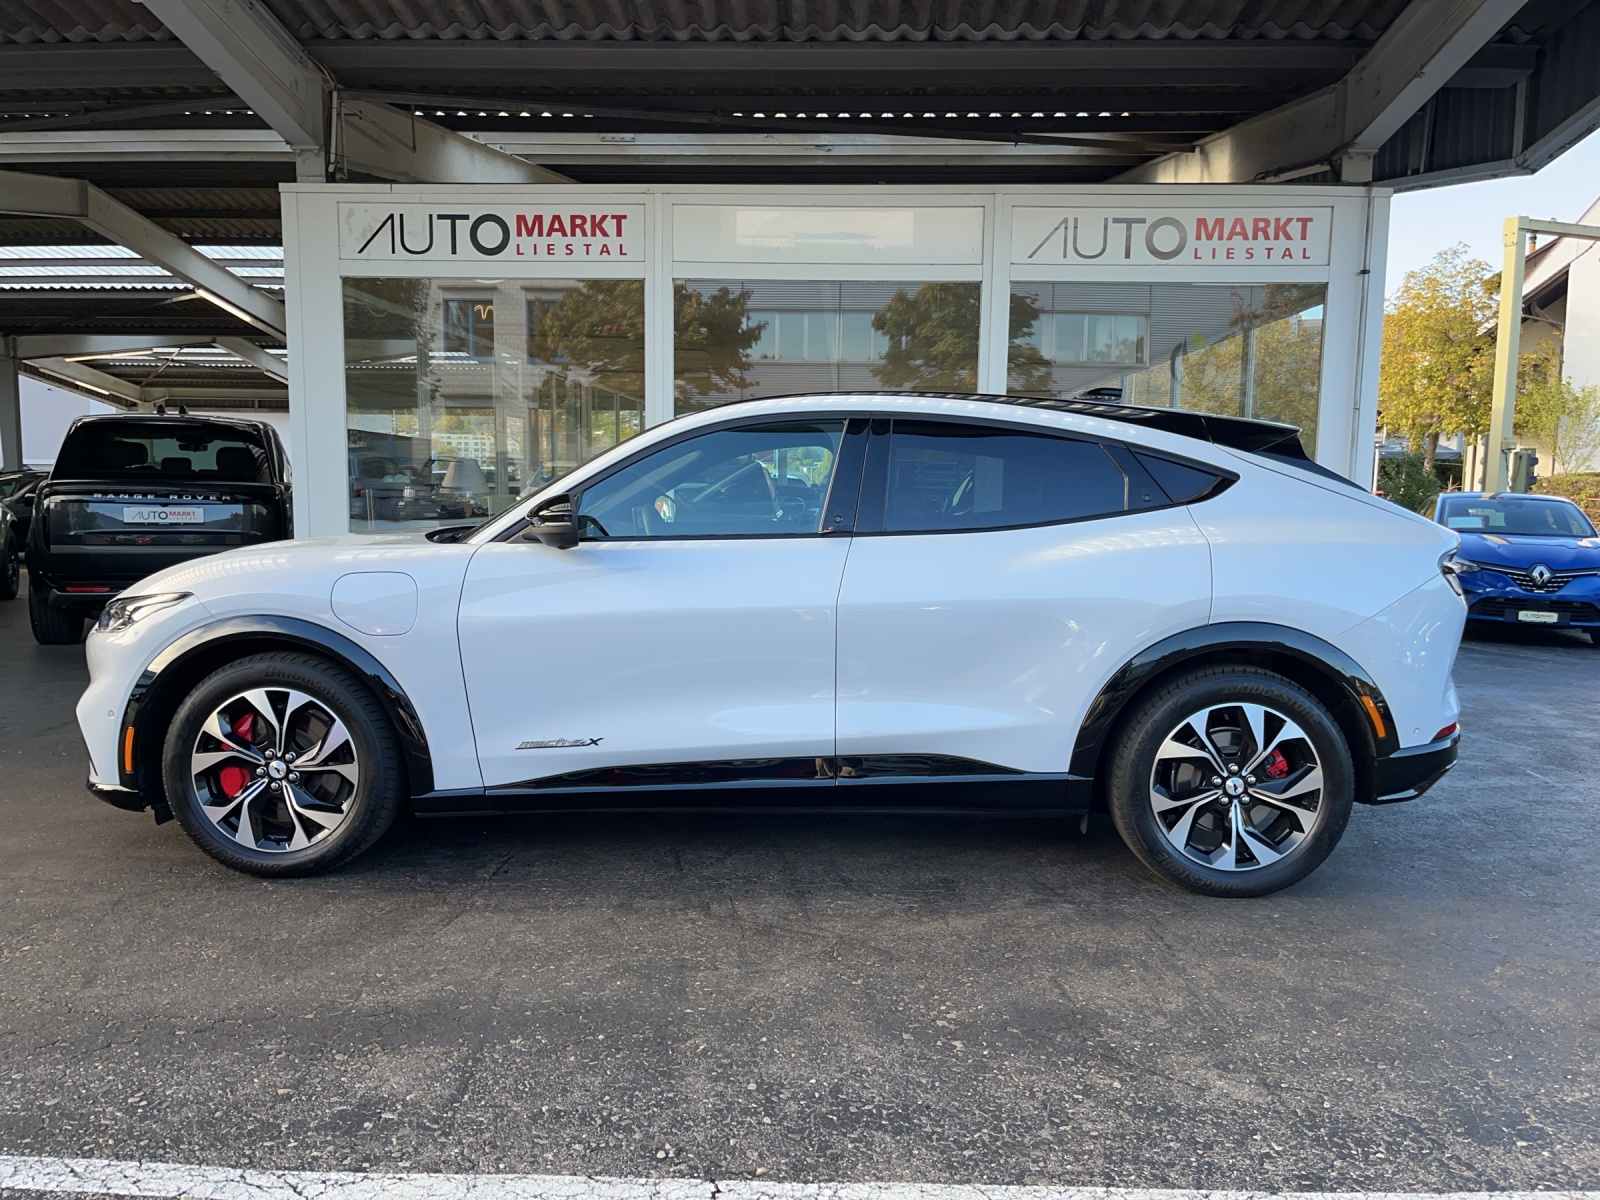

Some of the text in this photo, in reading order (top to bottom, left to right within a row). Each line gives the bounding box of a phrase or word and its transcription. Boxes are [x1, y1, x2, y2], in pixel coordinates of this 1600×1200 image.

[357, 213, 628, 256] AUTO MARKT
[1027, 217, 1314, 260] AUTO MARKT
[516, 243, 628, 256] LIESTAL
[1194, 247, 1311, 260] LIESTAL
[131, 510, 168, 520] AUTO
